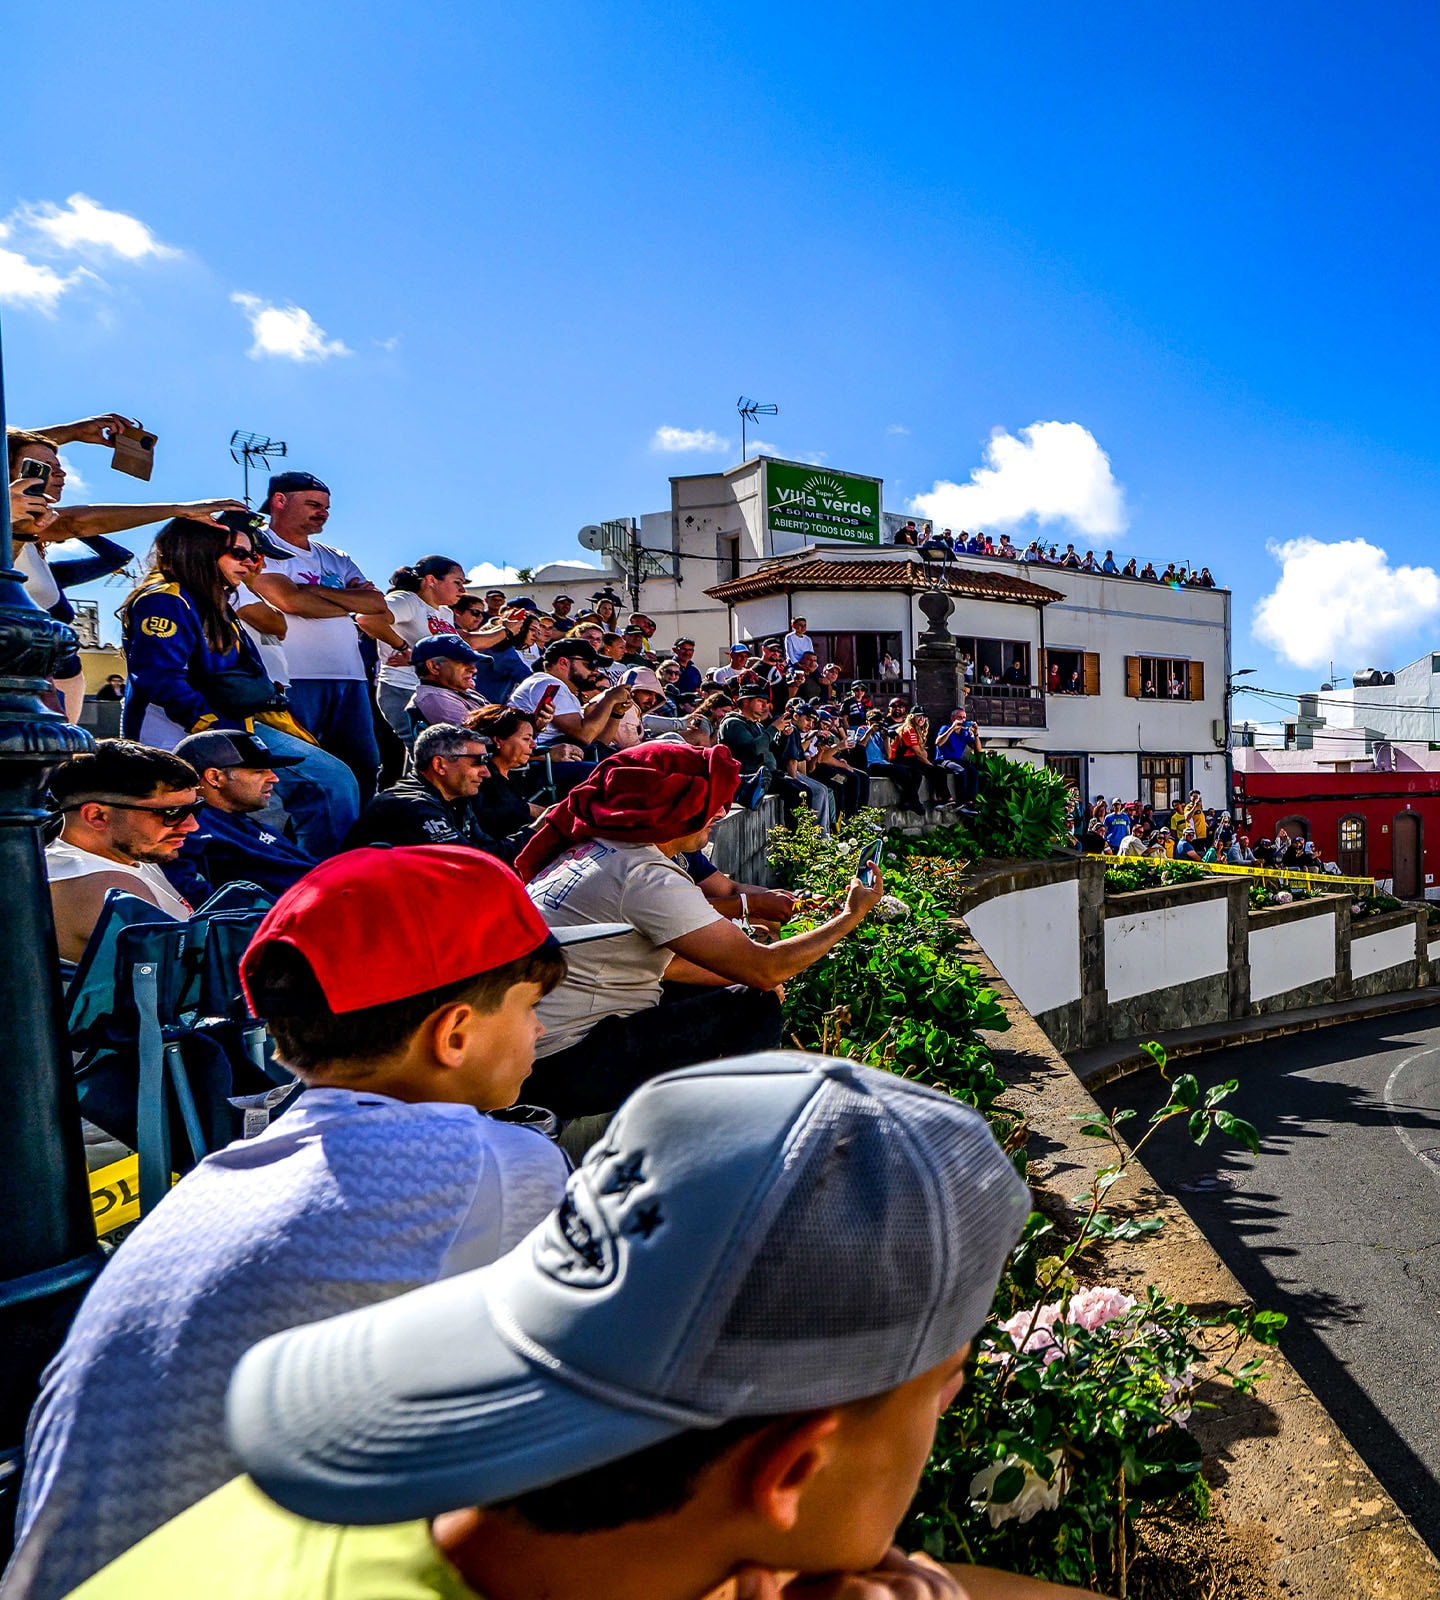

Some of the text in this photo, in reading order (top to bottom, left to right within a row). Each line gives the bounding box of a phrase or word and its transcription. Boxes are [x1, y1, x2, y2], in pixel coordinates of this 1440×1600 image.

[775, 486, 872, 518] Villa verde
[772, 506, 783, 514] A
[805, 511, 860, 526] METROS
[774, 518, 874, 541] ABIERTO TODOS LOS DÍAS
